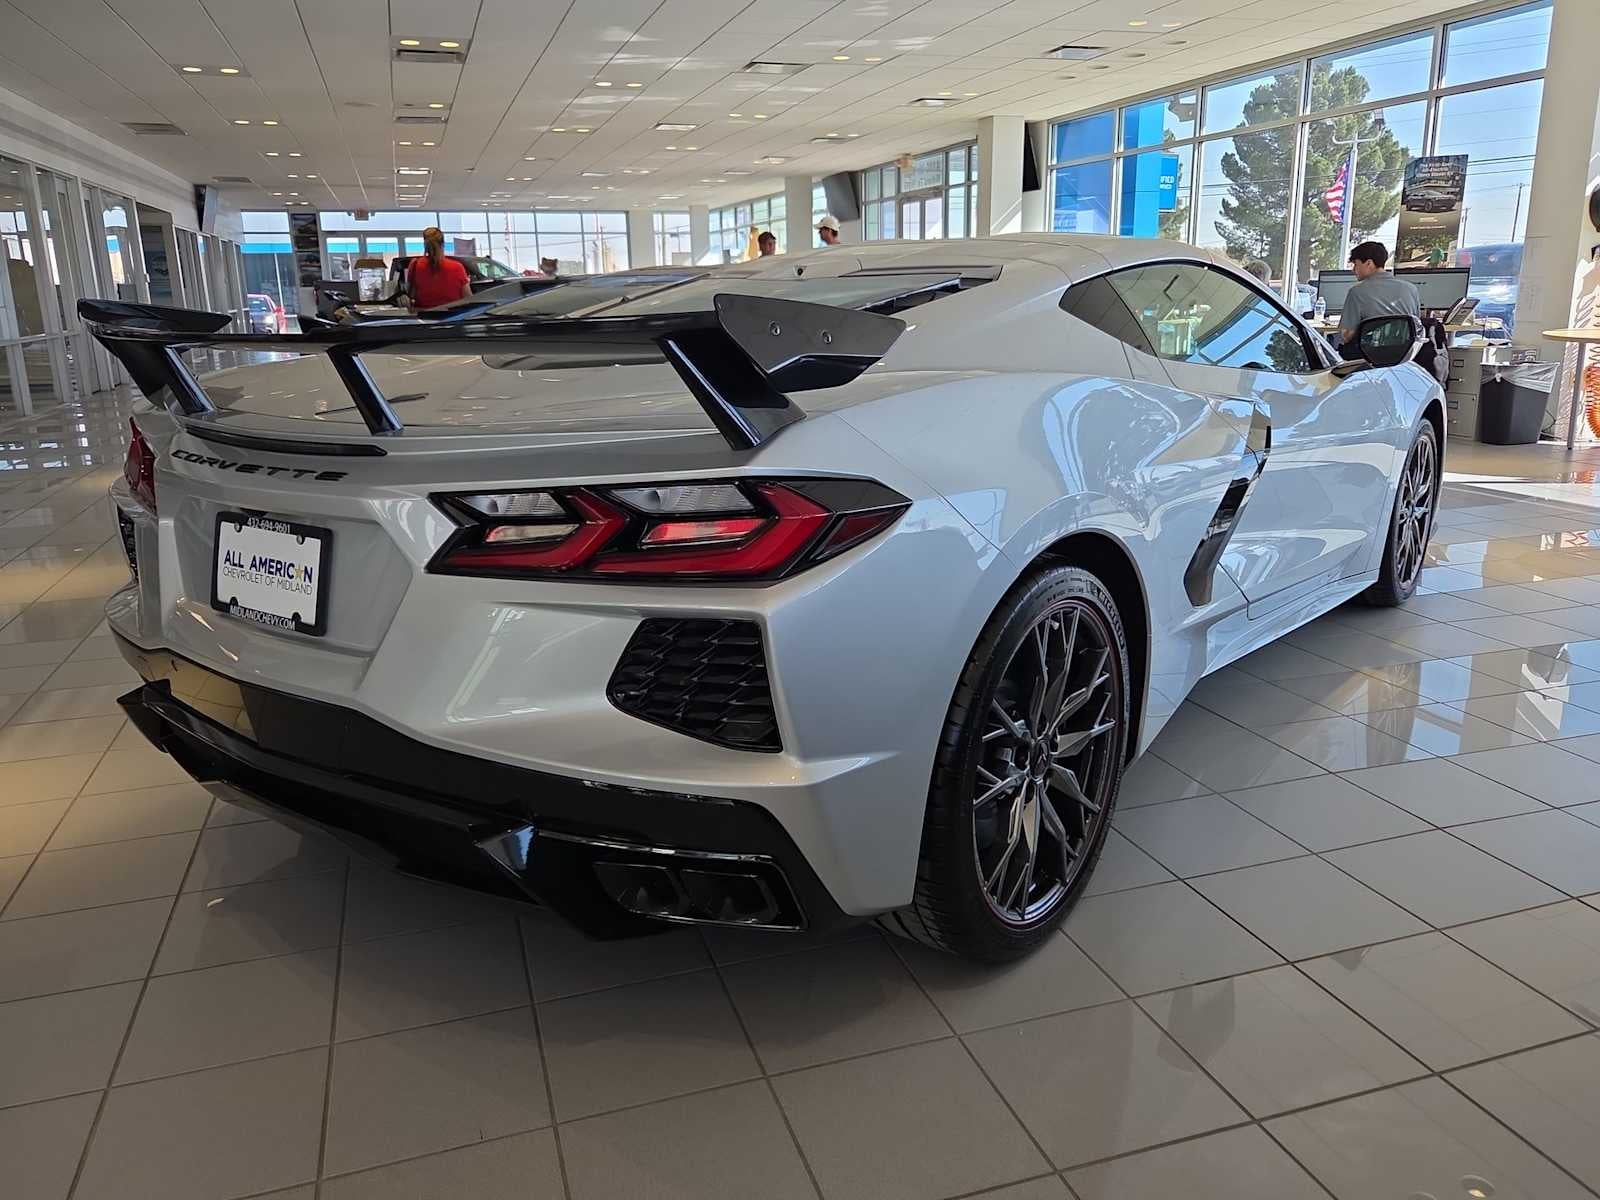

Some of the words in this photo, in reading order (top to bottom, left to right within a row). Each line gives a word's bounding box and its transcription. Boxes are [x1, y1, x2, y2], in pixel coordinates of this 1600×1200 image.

[171, 449, 349, 482] CORVETTE
[247, 517, 291, 534] 432-694-9601
[223, 549, 244, 569] ALL
[223, 566, 264, 584] CHEVROLET
[264, 576, 276, 587] OF
[276, 579, 313, 596] MIDLAND
[230, 605, 296, 631] MIDLANDCHEVY.COM
